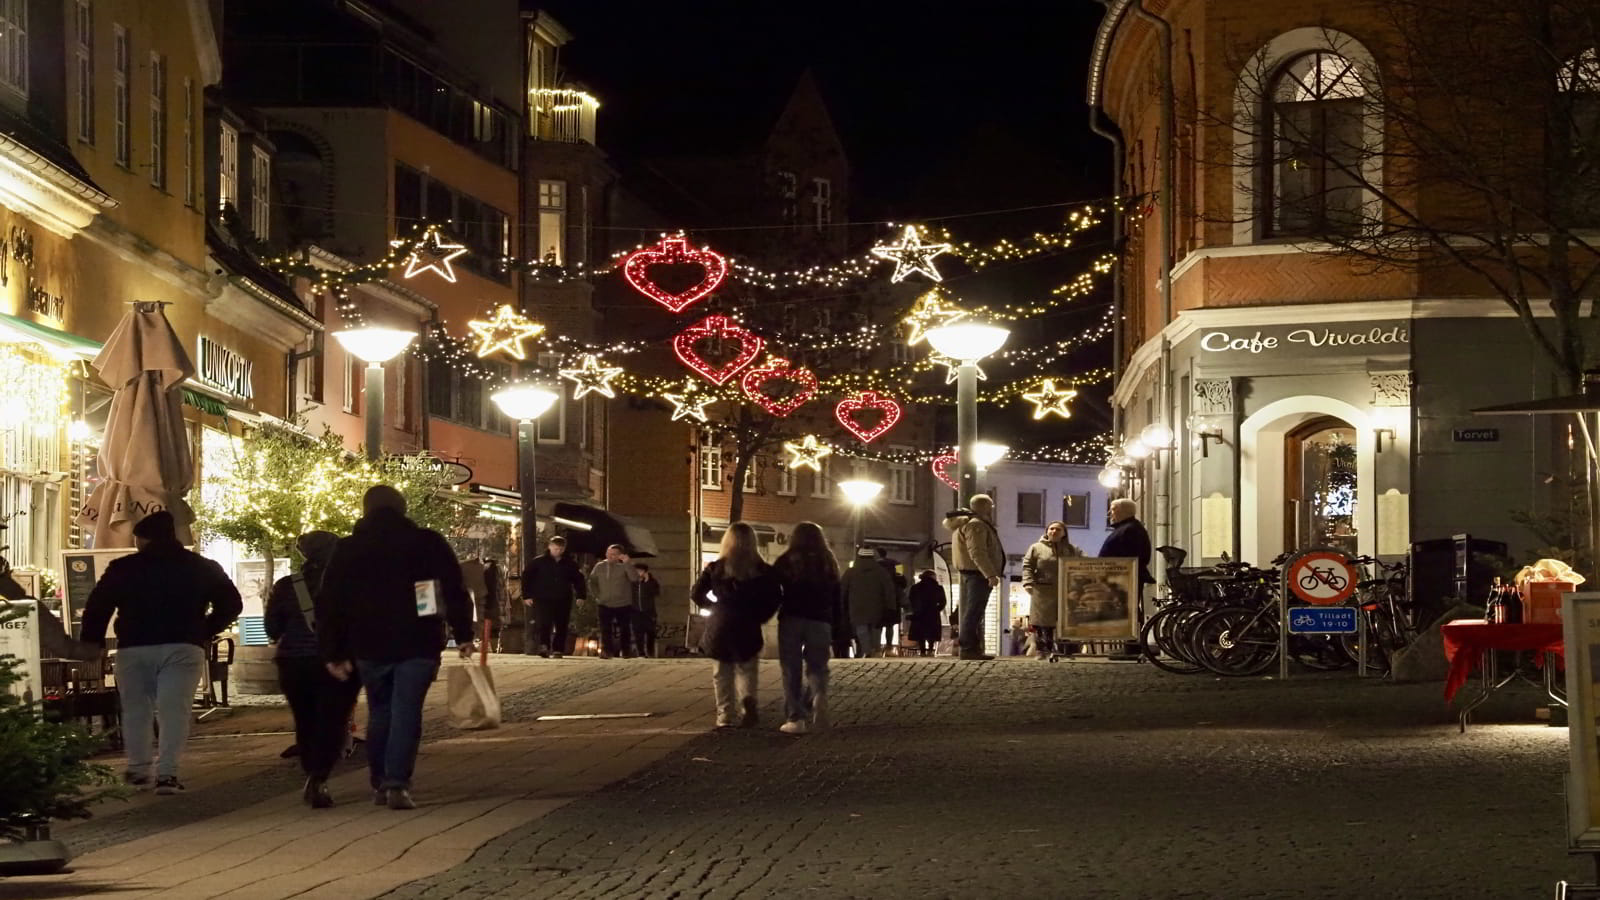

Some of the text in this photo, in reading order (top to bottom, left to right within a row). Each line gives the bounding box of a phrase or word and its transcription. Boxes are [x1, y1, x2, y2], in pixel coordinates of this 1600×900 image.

[1201, 327, 1410, 354] Cafe Vivaldi
[1457, 429, 1495, 440] Torvet
